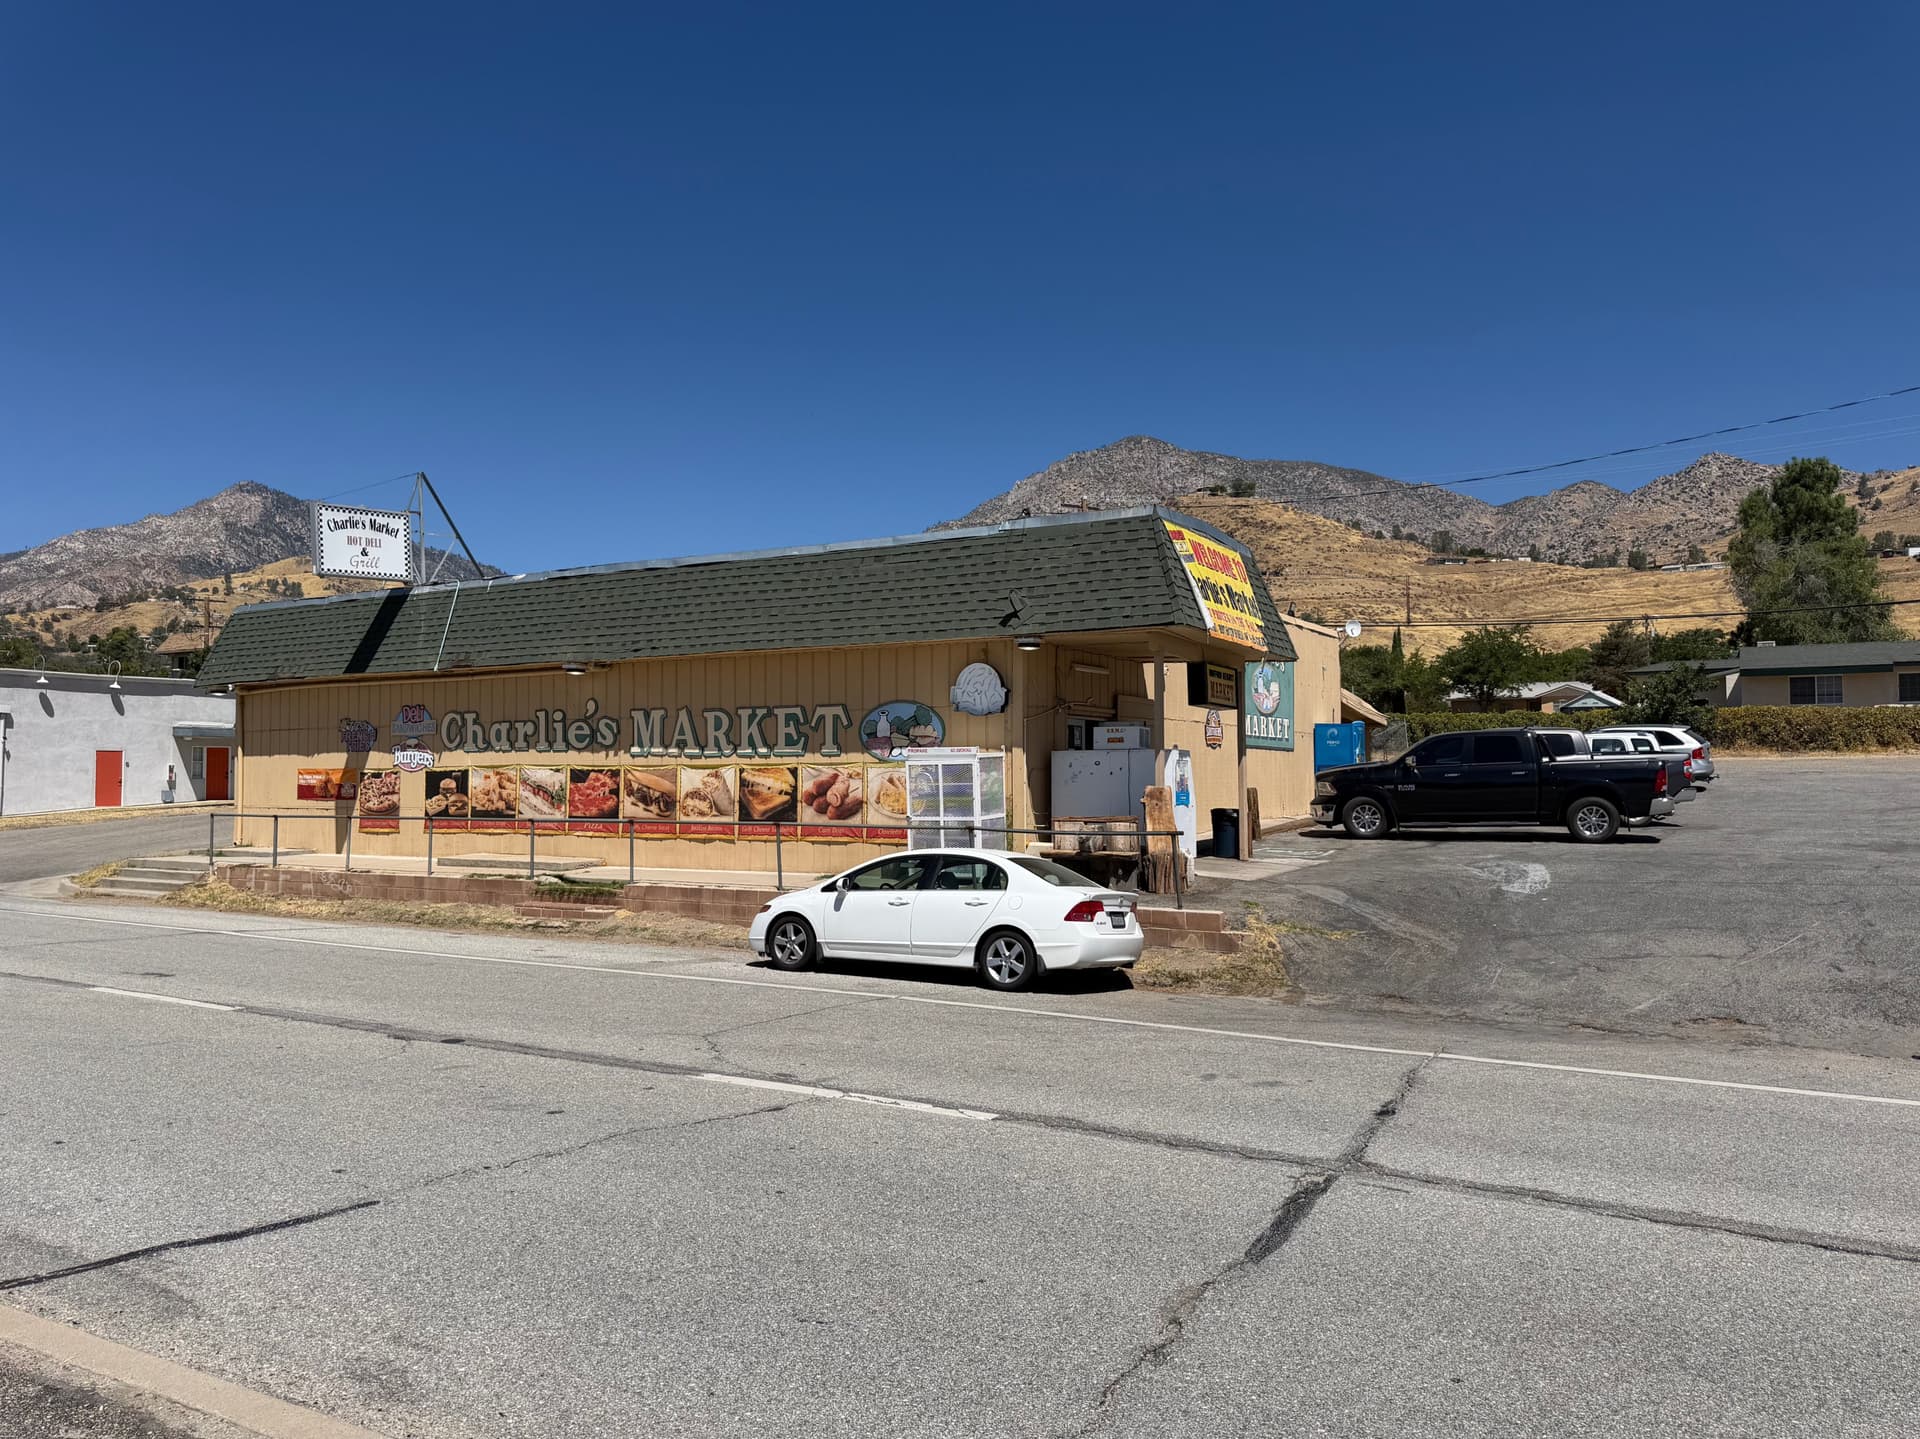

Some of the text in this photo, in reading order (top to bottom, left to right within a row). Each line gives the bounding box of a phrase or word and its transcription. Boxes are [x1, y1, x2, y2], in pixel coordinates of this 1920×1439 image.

[326, 515, 400, 539] Charlie's Market
[346, 535, 382, 548] HOT DELI
[360, 546, 370, 557] &
[349, 554, 381, 569] Grill
[1188, 538, 1248, 585] WELCOME TO
[401, 703, 425, 724] Deli
[440, 697, 852, 759] Charlie's MARKET
[1245, 714, 1290, 739] MARKET
[392, 744, 435, 769] Burgers
